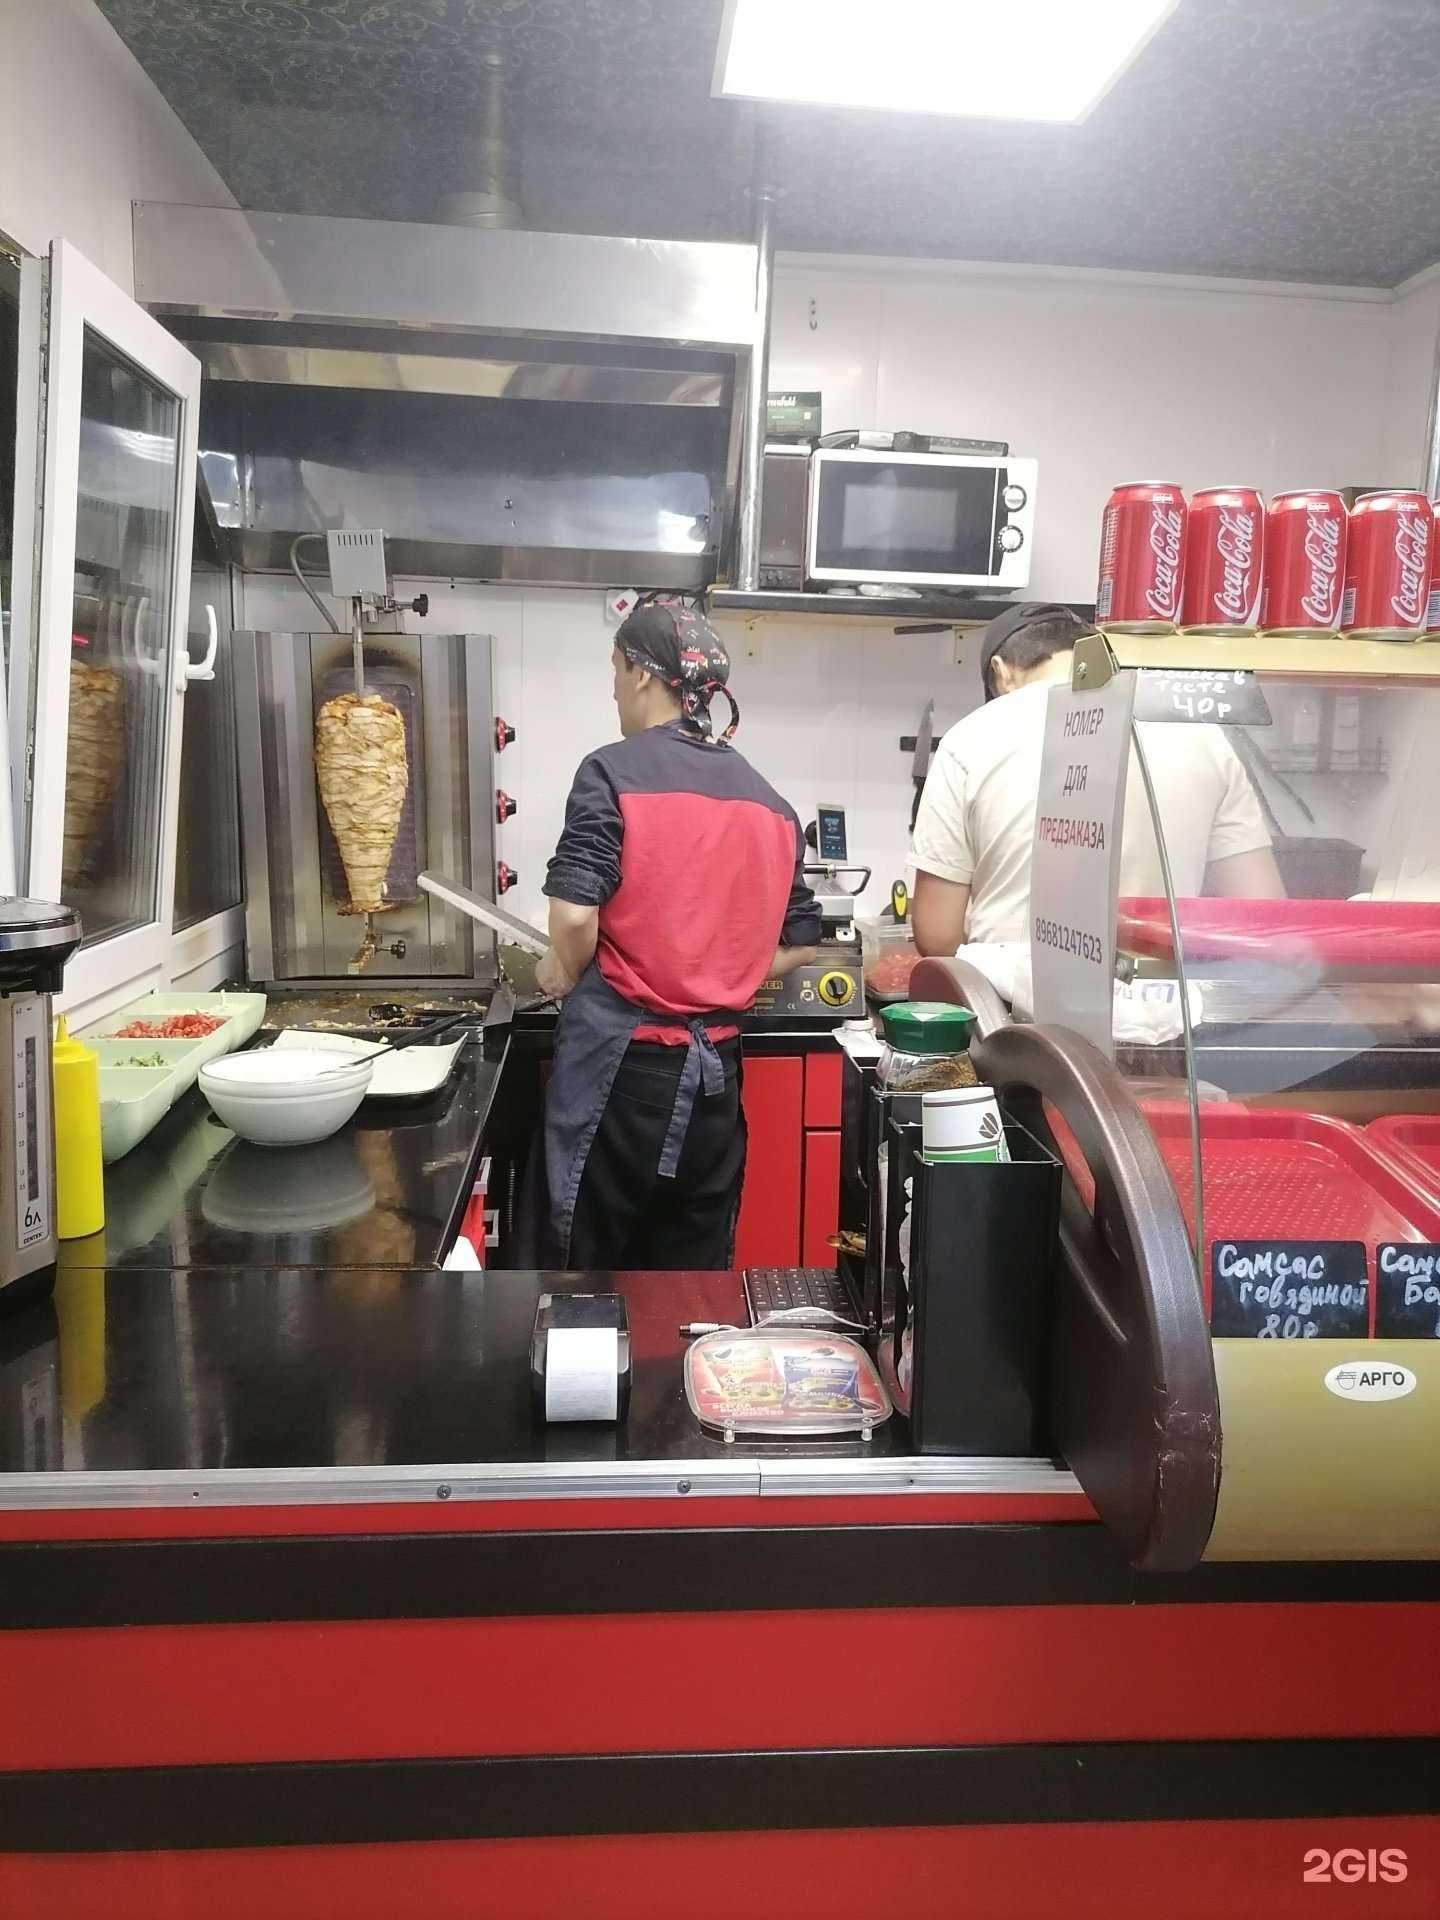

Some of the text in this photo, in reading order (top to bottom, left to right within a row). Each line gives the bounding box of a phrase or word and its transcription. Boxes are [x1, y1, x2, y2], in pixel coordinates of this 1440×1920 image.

[1173, 694, 1232, 718] 40р
[1064, 707, 1104, 737] НОМЕР
[1063, 765, 1088, 796] ДЛЯ
[1039, 816, 1105, 850] ПРЕДЗАКАЗА
[1035, 918, 1103, 964] 89681247623
[1239, 1277, 1369, 1315] говядиной
[1359, 1371, 1405, 1387] АРГО
